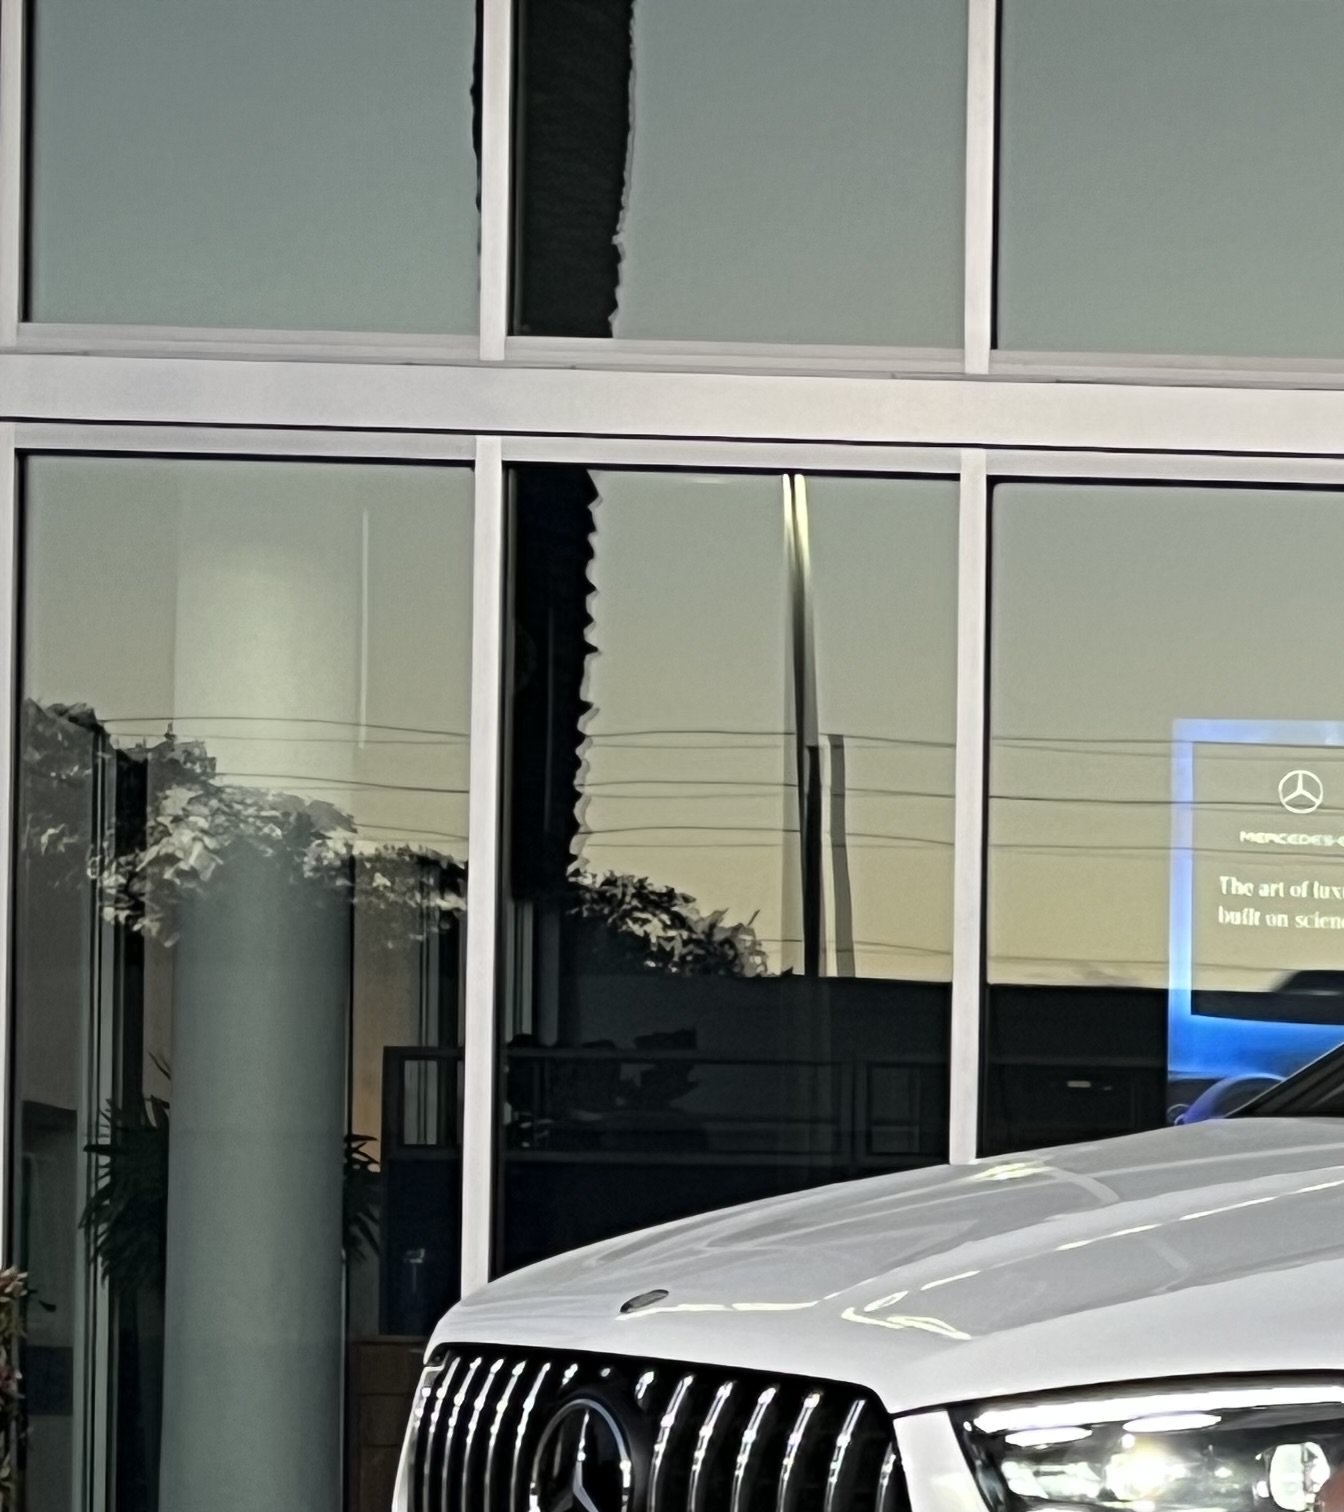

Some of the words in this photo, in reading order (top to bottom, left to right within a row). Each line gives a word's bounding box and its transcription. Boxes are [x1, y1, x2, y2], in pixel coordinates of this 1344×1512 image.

[1219, 875, 1254, 897] The
[1258, 882, 1285, 898] art
[1289, 880, 1310, 898] of
[1218, 905, 1261, 926] built
[1265, 913, 1289, 928] on
